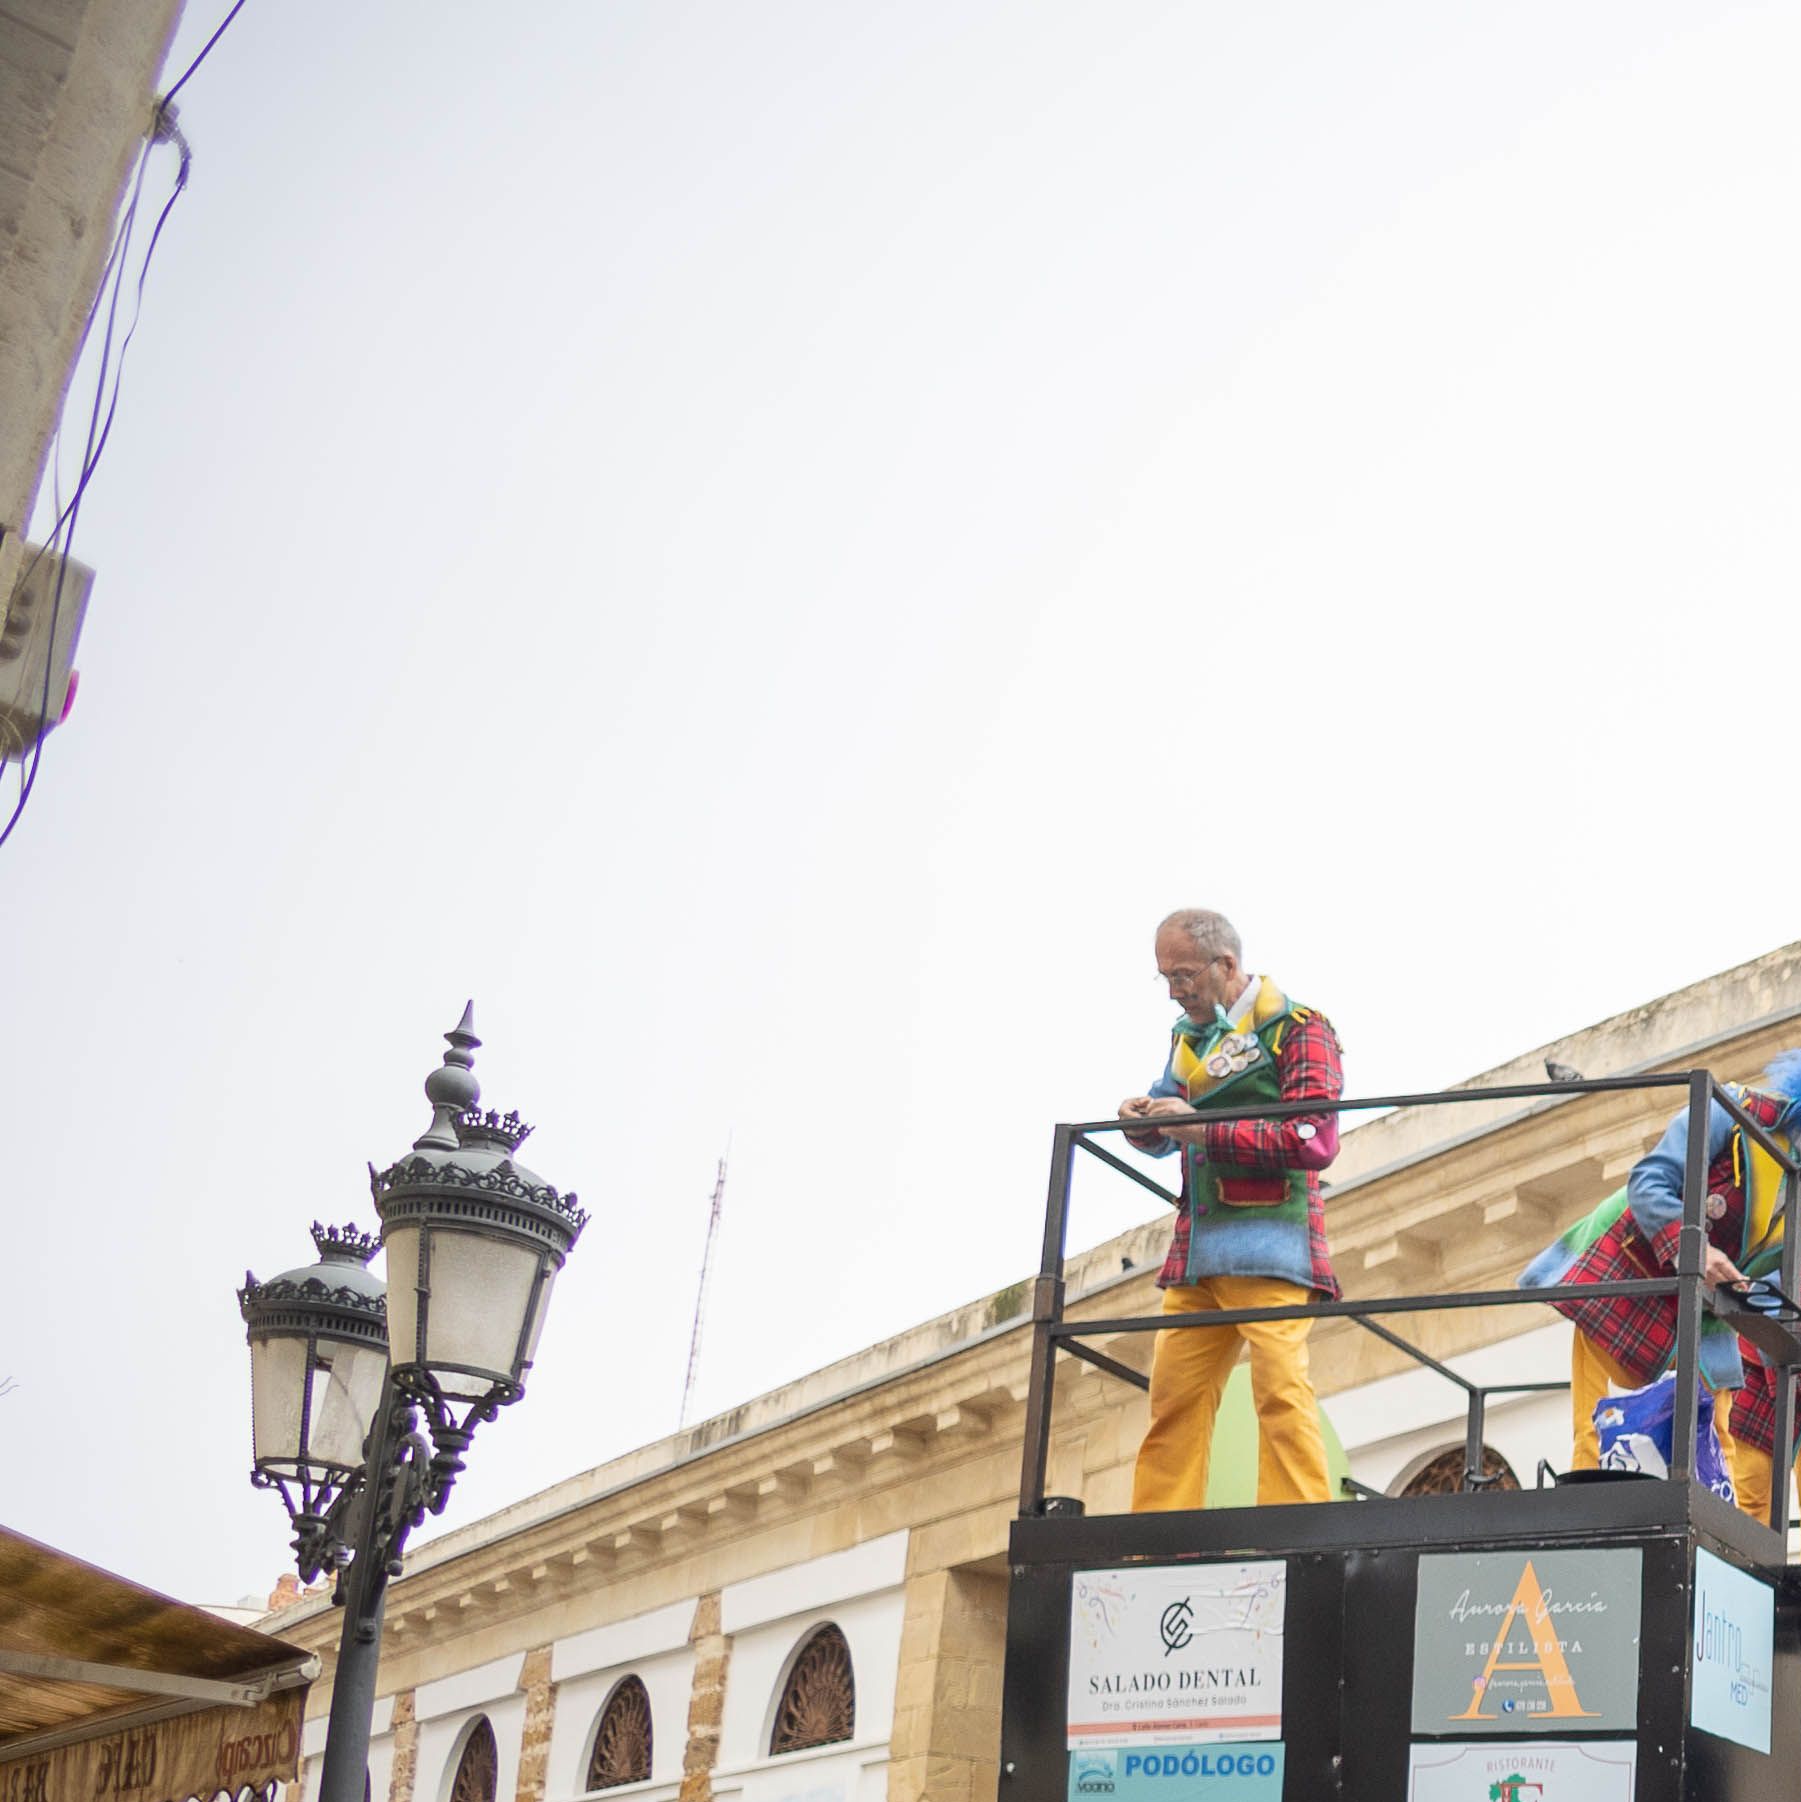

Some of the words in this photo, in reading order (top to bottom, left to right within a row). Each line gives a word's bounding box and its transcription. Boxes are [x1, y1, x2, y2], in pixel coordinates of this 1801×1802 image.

[1450, 1589, 1529, 1623] Aurora
[1465, 1640, 1582, 1656] ESTILISTA
[1089, 1671, 1171, 1696] SALADO
[1179, 1667, 1262, 1690] DENTAL
[1125, 1698, 1164, 1711] Cristina
[1125, 1750, 1275, 1778] PODÓLOGO
[1486, 1757, 1556, 1773] RISTORANTE
